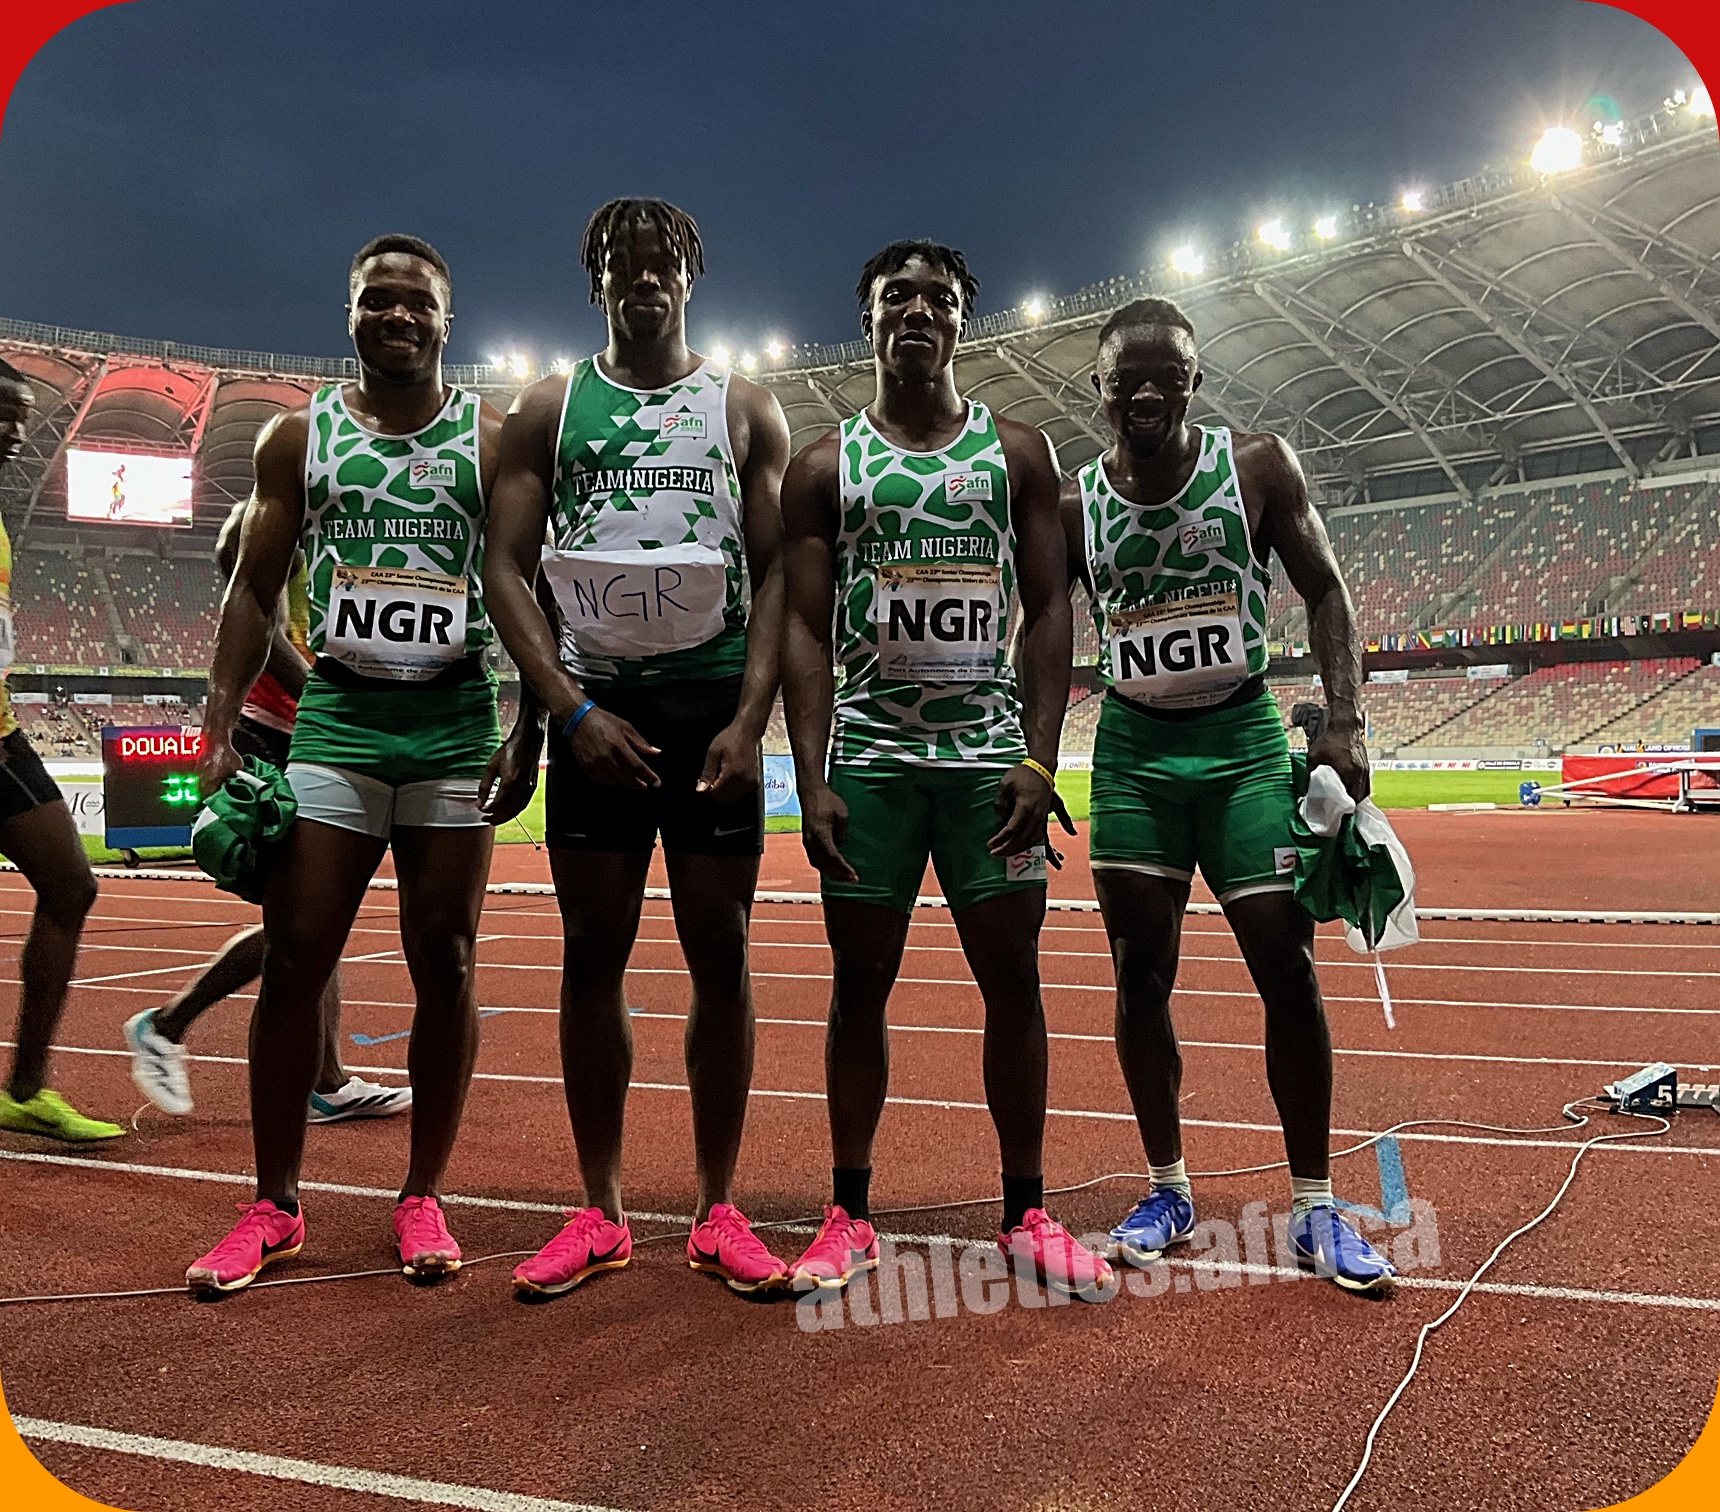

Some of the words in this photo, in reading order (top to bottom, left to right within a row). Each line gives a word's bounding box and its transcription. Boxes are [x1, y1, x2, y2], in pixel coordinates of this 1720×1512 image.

[681, 417, 703, 427] afn
[430, 464, 453, 475] afn
[573, 470, 628, 496] TEAM
[632, 469, 714, 494] NIGERIA
[966, 476, 989, 488] afn
[325, 519, 375, 539] TEAM
[384, 519, 464, 540] NIGERIA
[1199, 525, 1222, 539] afn
[861, 539, 912, 562] TEAM
[921, 536, 995, 559] NIGERIA
[415, 575, 457, 587] Championships
[573, 566, 689, 622] NGR
[335, 598, 454, 646] NGR
[888, 599, 993, 642] NGR
[1119, 625, 1232, 680] NGR
[1657, 1085, 1673, 1107] 5
